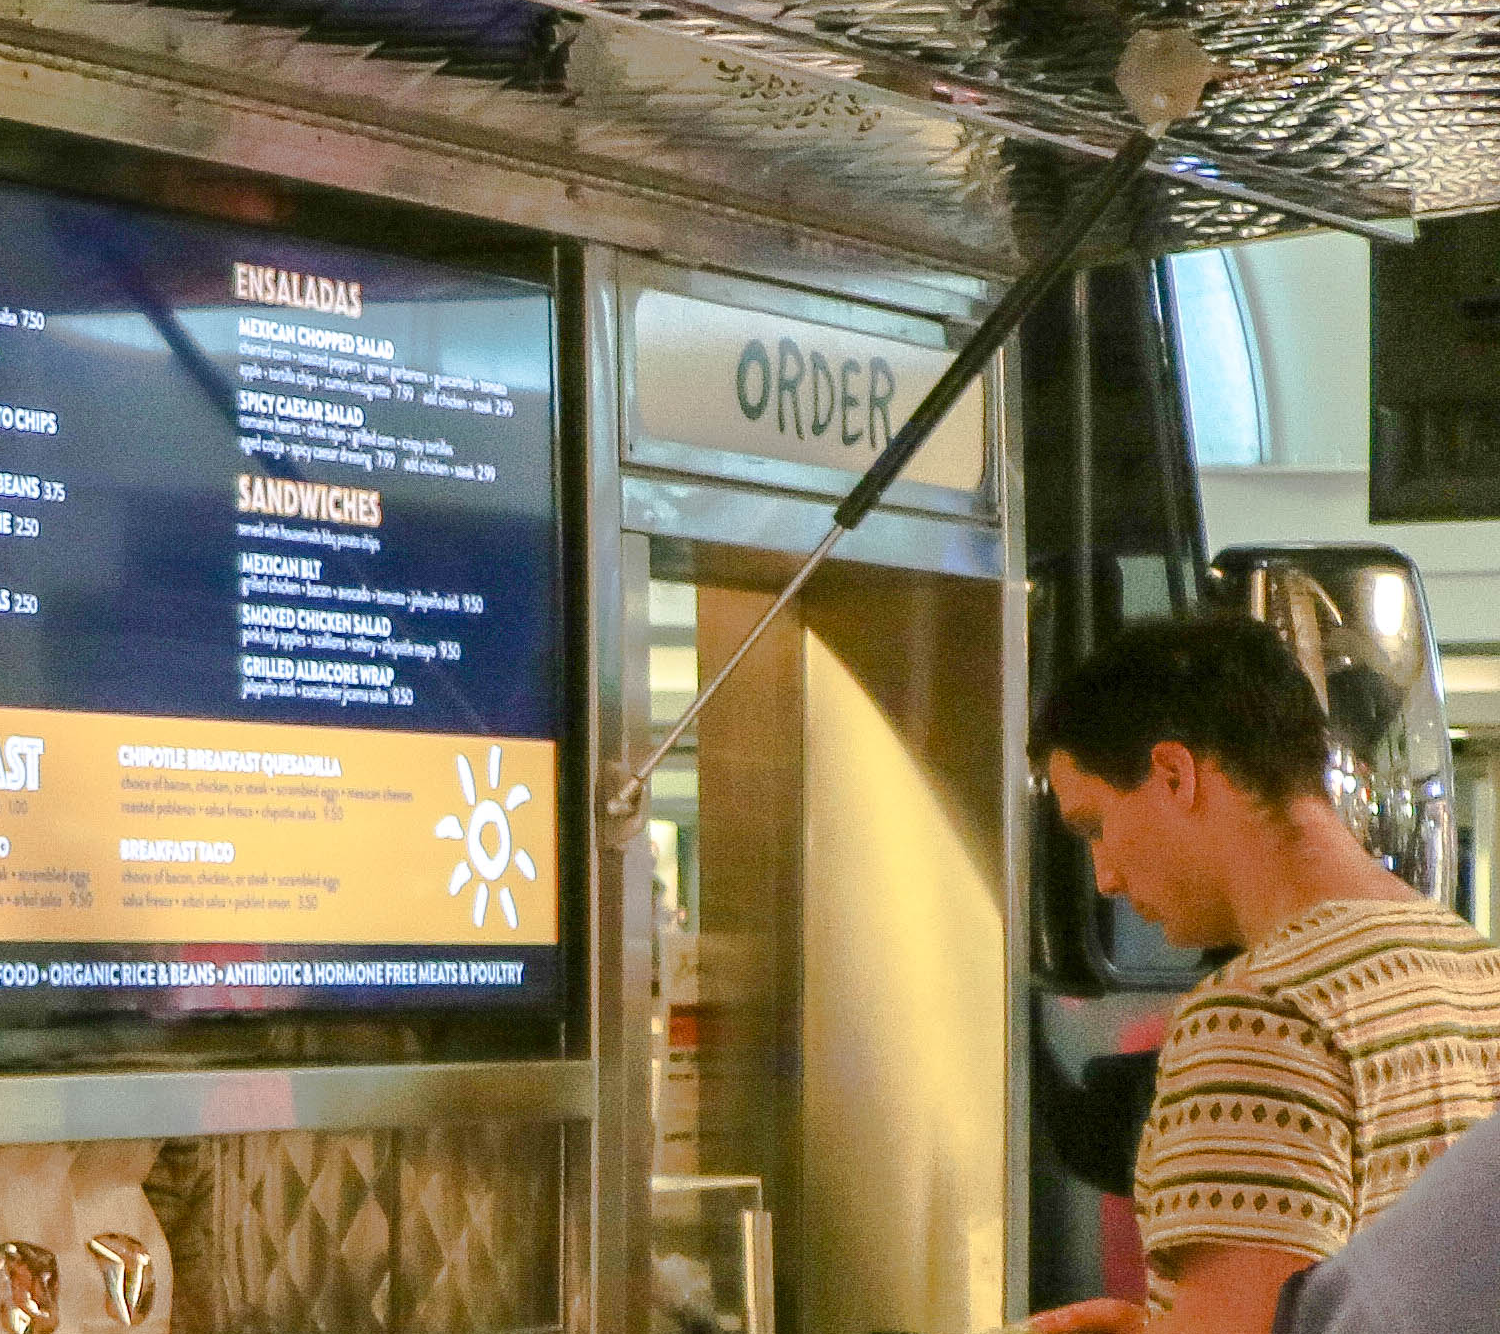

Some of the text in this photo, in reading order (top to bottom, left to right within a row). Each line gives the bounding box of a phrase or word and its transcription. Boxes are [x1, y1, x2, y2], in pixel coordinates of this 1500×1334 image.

[235, 263, 363, 320] ENSALADAS
[237, 316, 395, 360] MEXICAN CHOPPED SALAD
[238, 389, 367, 431] SPICY CAESAR SALAD
[735, 335, 896, 451] ORDER
[14, 407, 58, 435] CHIPS
[237, 474, 380, 526] SANDWICHES
[241, 602, 392, 638] SMOKED CHICKEN SALAD
